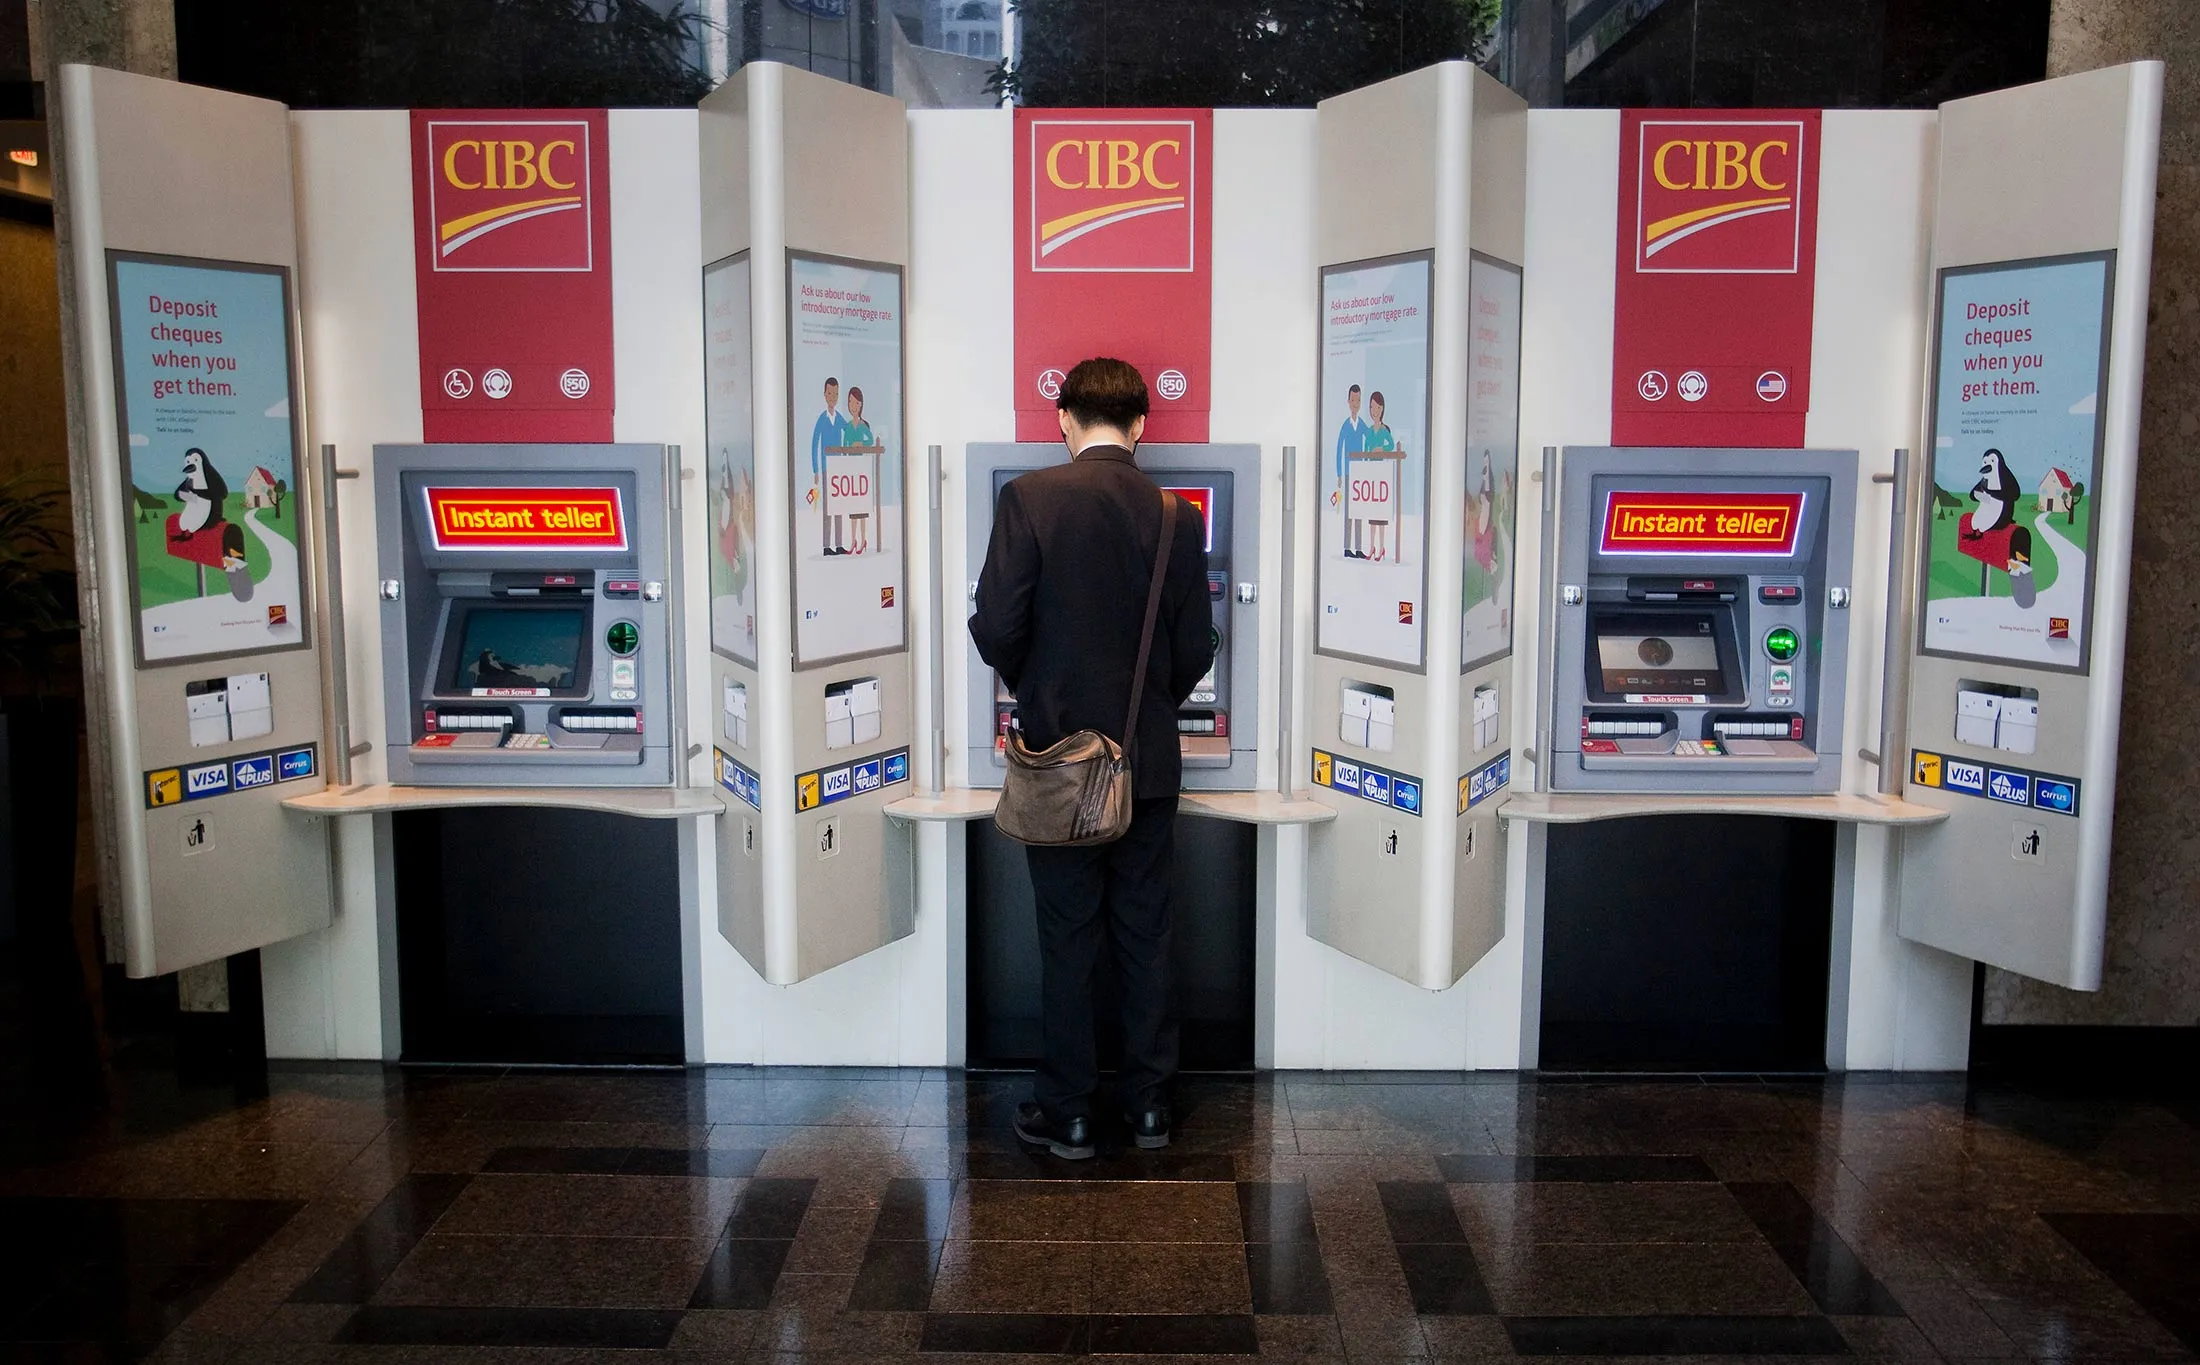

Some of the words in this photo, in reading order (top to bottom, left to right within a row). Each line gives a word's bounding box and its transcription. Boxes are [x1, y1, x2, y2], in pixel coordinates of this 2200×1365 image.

[444, 140, 576, 190] CIBC
[1046, 140, 1181, 190] CIBC
[1653, 140, 1788, 191] CIBC
[801, 284, 814, 296] Ask
[816, 288, 823, 298] us
[824, 288, 845, 301] about
[846, 292, 858, 302] our
[859, 292, 871, 303] low
[1331, 300, 1341, 311] Ask
[1342, 301, 1350, 310] us
[1351, 297, 1369, 308] about
[1370, 297, 1382, 305] our
[1382, 293, 1395, 304] low
[149, 295, 218, 320] Deposit
[801, 300, 845, 319] introductory
[845, 307, 878, 322] mortgage
[1967, 298, 2030, 323] Deposit
[1330, 313, 1369, 326] introductory
[1369, 310, 1402, 322] mortgage
[151, 323, 223, 347] cheques
[1965, 328, 2032, 348] cheques
[152, 350, 200, 369] when
[205, 356, 237, 374] you
[1964, 353, 2007, 371] when
[2012, 354, 2043, 374] you
[154, 378, 183, 399] get
[188, 377, 237, 397] them.
[1962, 381, 1988, 402] get
[1993, 378, 2040, 396] them.
[832, 475, 868, 497] SOLD
[1352, 480, 1389, 502] SOLD
[451, 507, 534, 529] Instant
[541, 507, 605, 529] teller
[1622, 512, 1706, 534] Instant
[1716, 512, 1780, 534] teller
[491, 688, 510, 696] Touch
[511, 688, 533, 696] Screen
[1646, 695, 1666, 703] Touch
[1667, 696, 1689, 704] Screen
[284, 760, 307, 771] Cirrus
[192, 770, 226, 787] VISA
[247, 769, 272, 785] PLUS
[826, 772, 849, 791] VISA
[862, 774, 879, 790] PLUS
[1337, 767, 1358, 785] VISA
[1951, 767, 1981, 785] VISA
[1369, 784, 1388, 801] PLUS
[1396, 790, 1415, 802] Cirrus
[2000, 786, 2026, 801] PLUS
[2041, 789, 2068, 802] Cirrus
